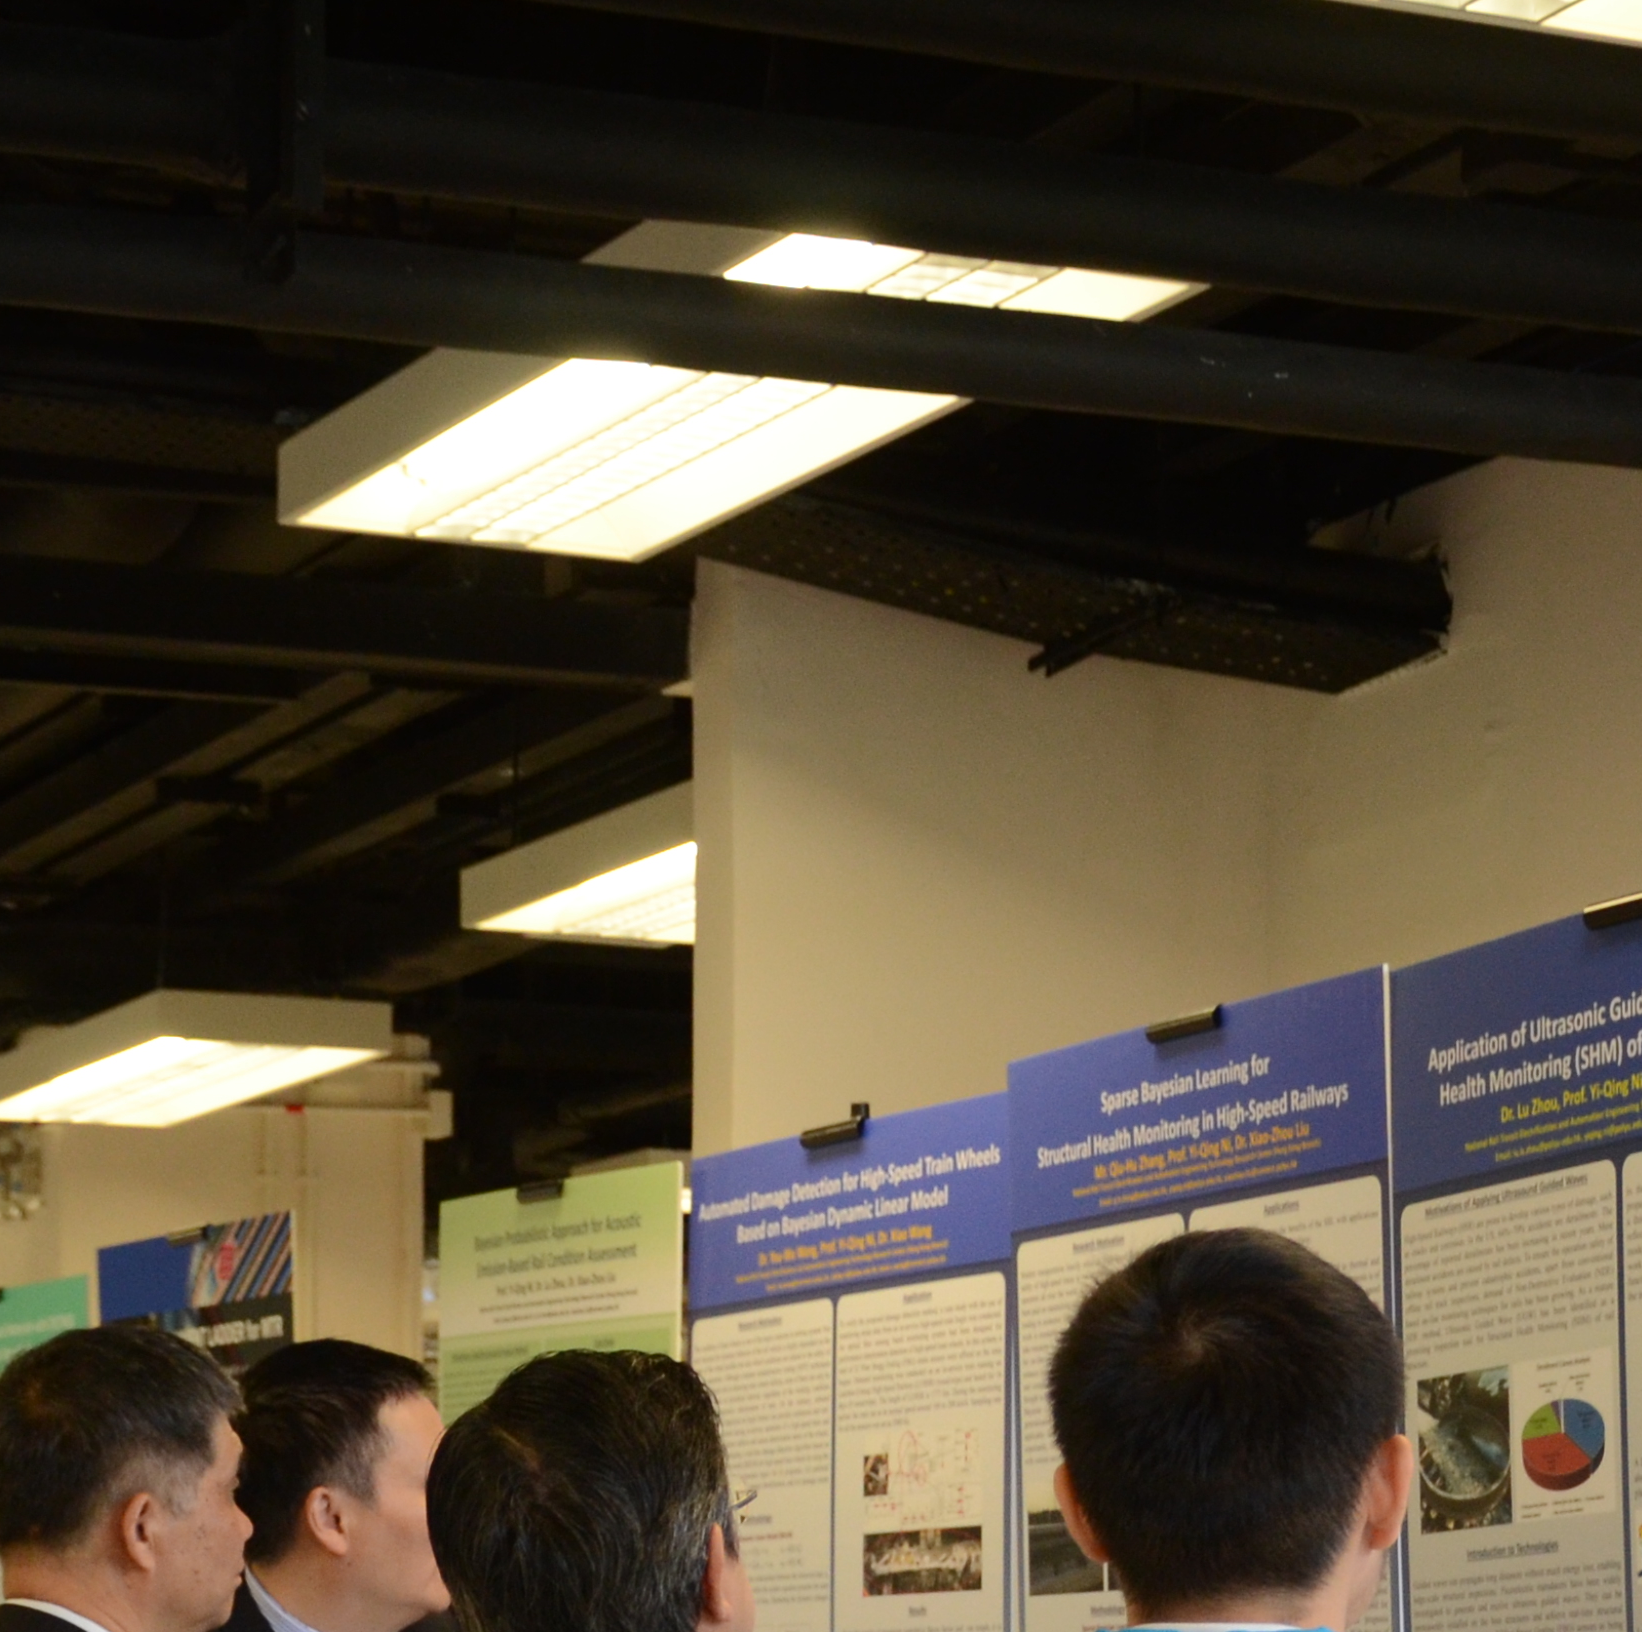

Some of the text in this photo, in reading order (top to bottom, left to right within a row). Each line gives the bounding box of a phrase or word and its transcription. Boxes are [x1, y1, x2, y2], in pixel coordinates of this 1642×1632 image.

[1428, 1031, 1507, 1074] Application
[1511, 1021, 1527, 1048] of
[1530, 1002, 1606, 1043] Ultrasonic
[1440, 1073, 1486, 1107] Health
[1489, 1053, 1572, 1093] Monitoring
[1575, 1035, 1622, 1076] (SHM)
[1100, 1053, 1271, 1114] Sparse Bayesian Learning for
[1501, 1105, 1515, 1123] Dr.
[1517, 1103, 1529, 1119] Lu
[1532, 1097, 1560, 1115] Zhou,
[1563, 1086, 1587, 1107] Prof.
[1590, 1078, 1629, 1100] Yi-Qing
[1038, 1083, 1349, 1168] Structural Health Monitoring in High-Speed Railways
[698, 1144, 1001, 1222] Automated Damage Detection for High-Speed Train Wheels
[737, 1185, 949, 1244] Based on Bayesian Dynamic Linear Model
[1467, 1546, 1507, 1561] Introduction
[1516, 1541, 1559, 1555] Technologies
